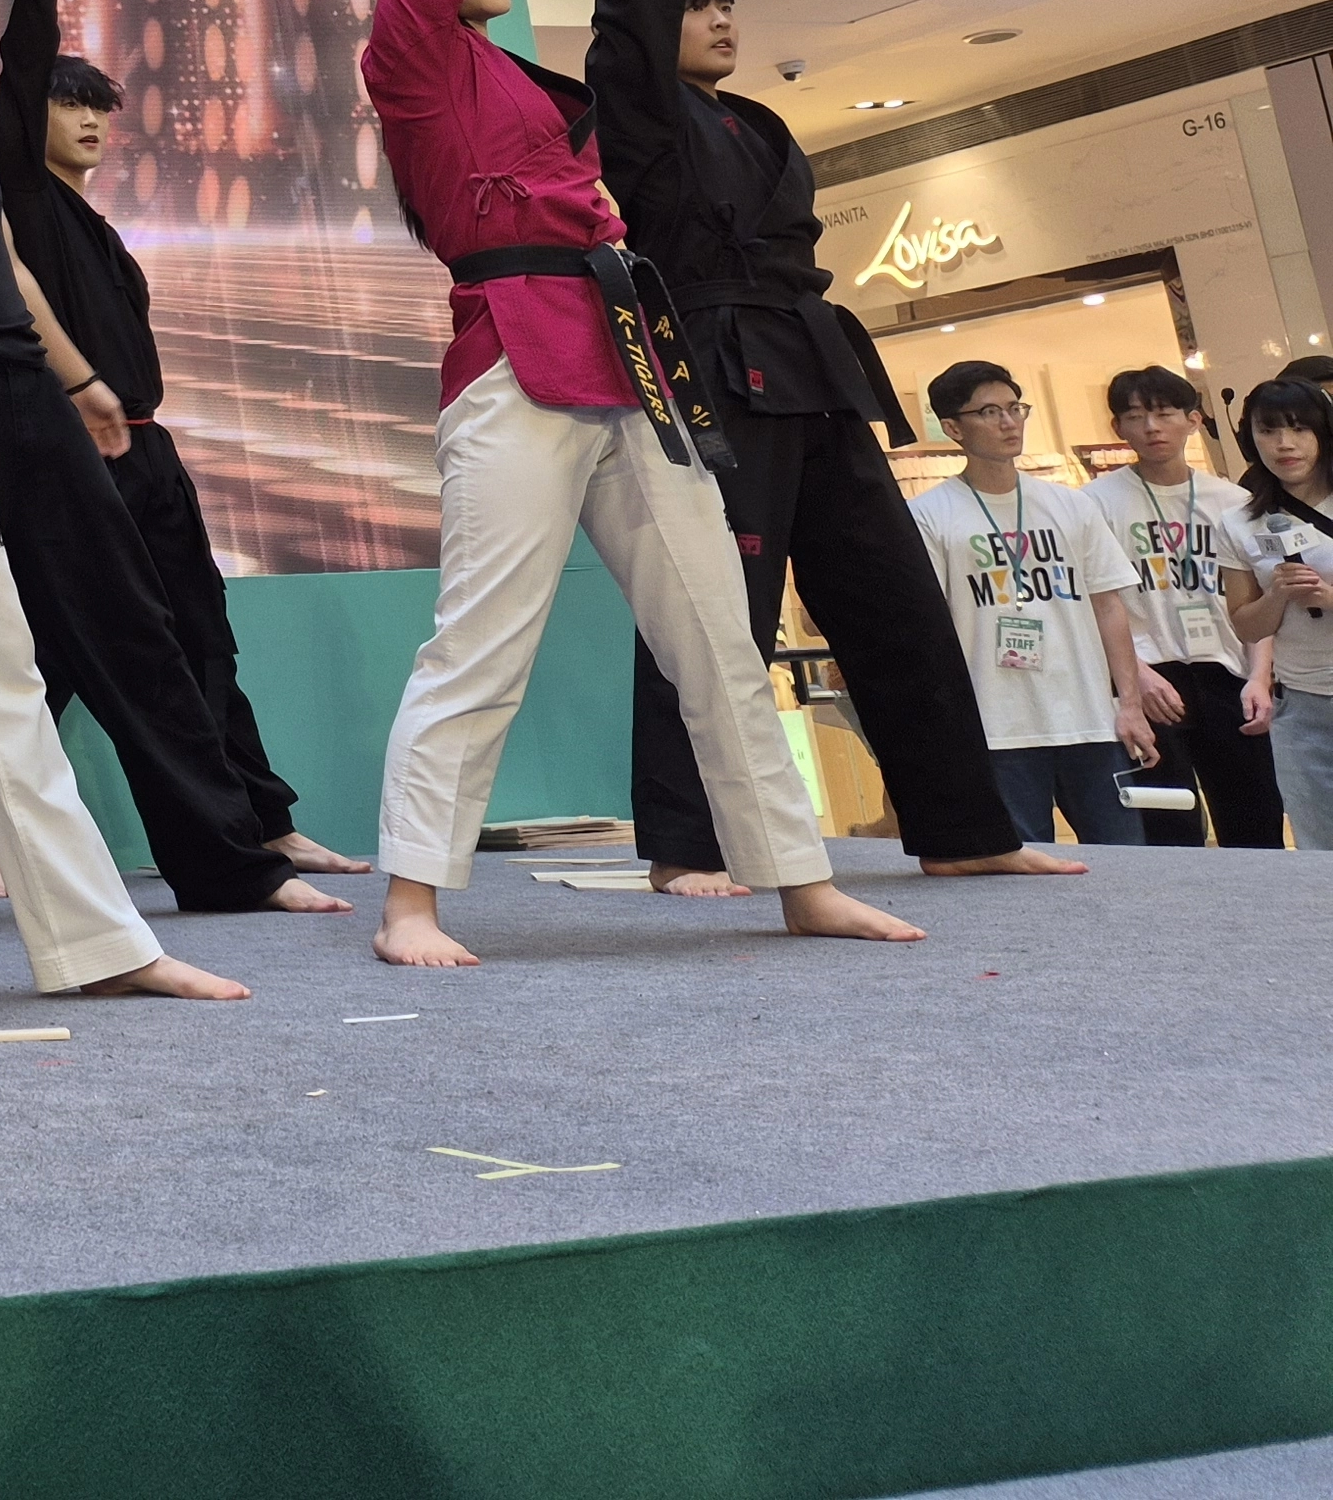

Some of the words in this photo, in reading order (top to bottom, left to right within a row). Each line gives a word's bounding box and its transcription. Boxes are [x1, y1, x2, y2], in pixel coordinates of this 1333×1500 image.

[1183, 111, 1226, 137] G-16
[821, 206, 869, 229] WANITA
[854, 201, 998, 289] Lovisa
[614, 305, 671, 425] K-TIGERS
[1005, 637, 1035, 650] STAFF
